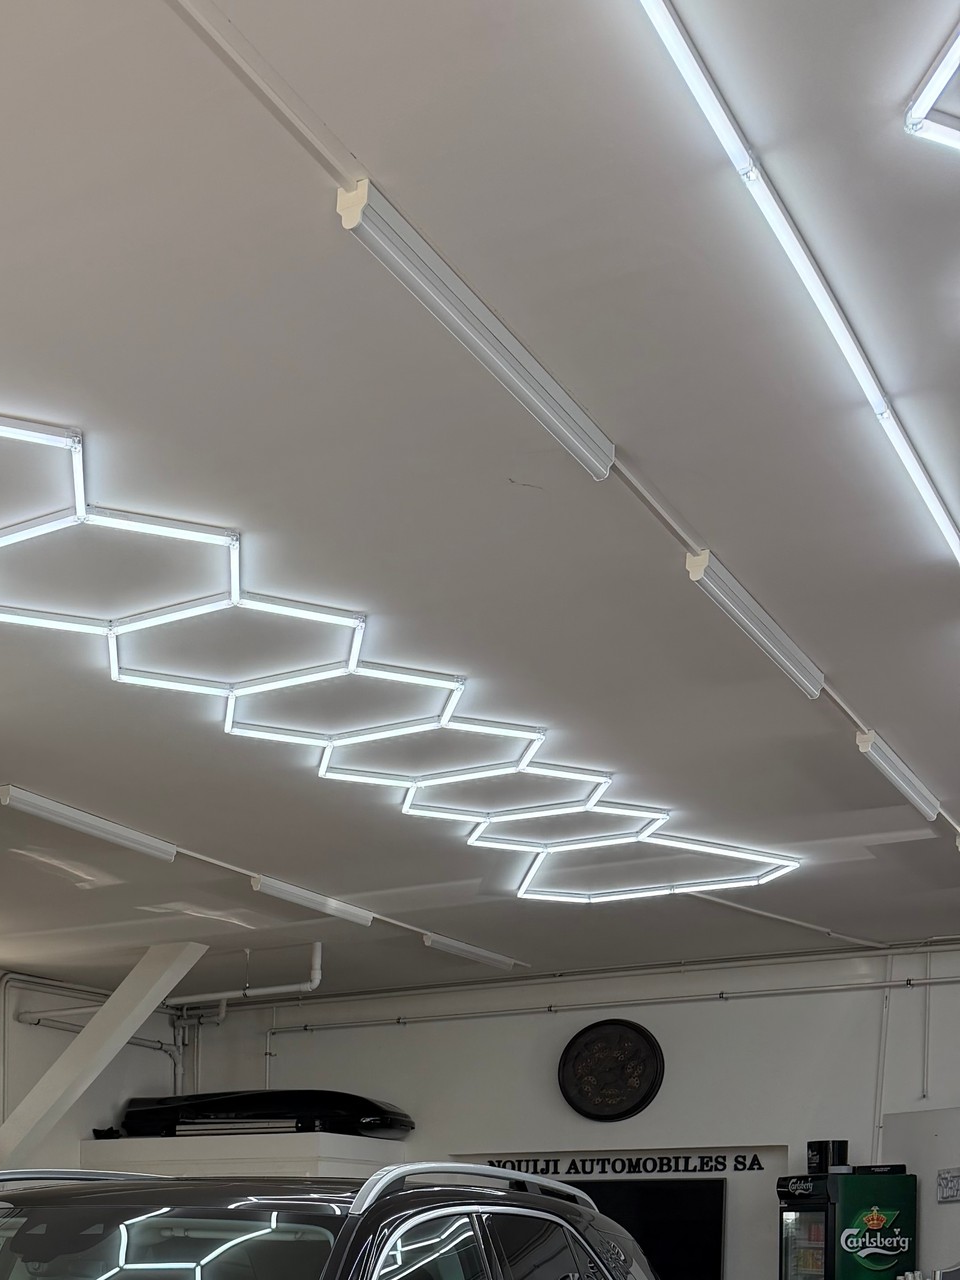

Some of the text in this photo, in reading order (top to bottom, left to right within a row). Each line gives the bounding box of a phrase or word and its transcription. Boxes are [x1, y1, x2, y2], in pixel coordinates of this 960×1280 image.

[565, 1155, 727, 1174] AUTOMOBILES
[733, 1154, 764, 1171] SA
[789, 1178, 813, 1193] Carlsberg
[841, 1228, 909, 1253] Carlsberg
